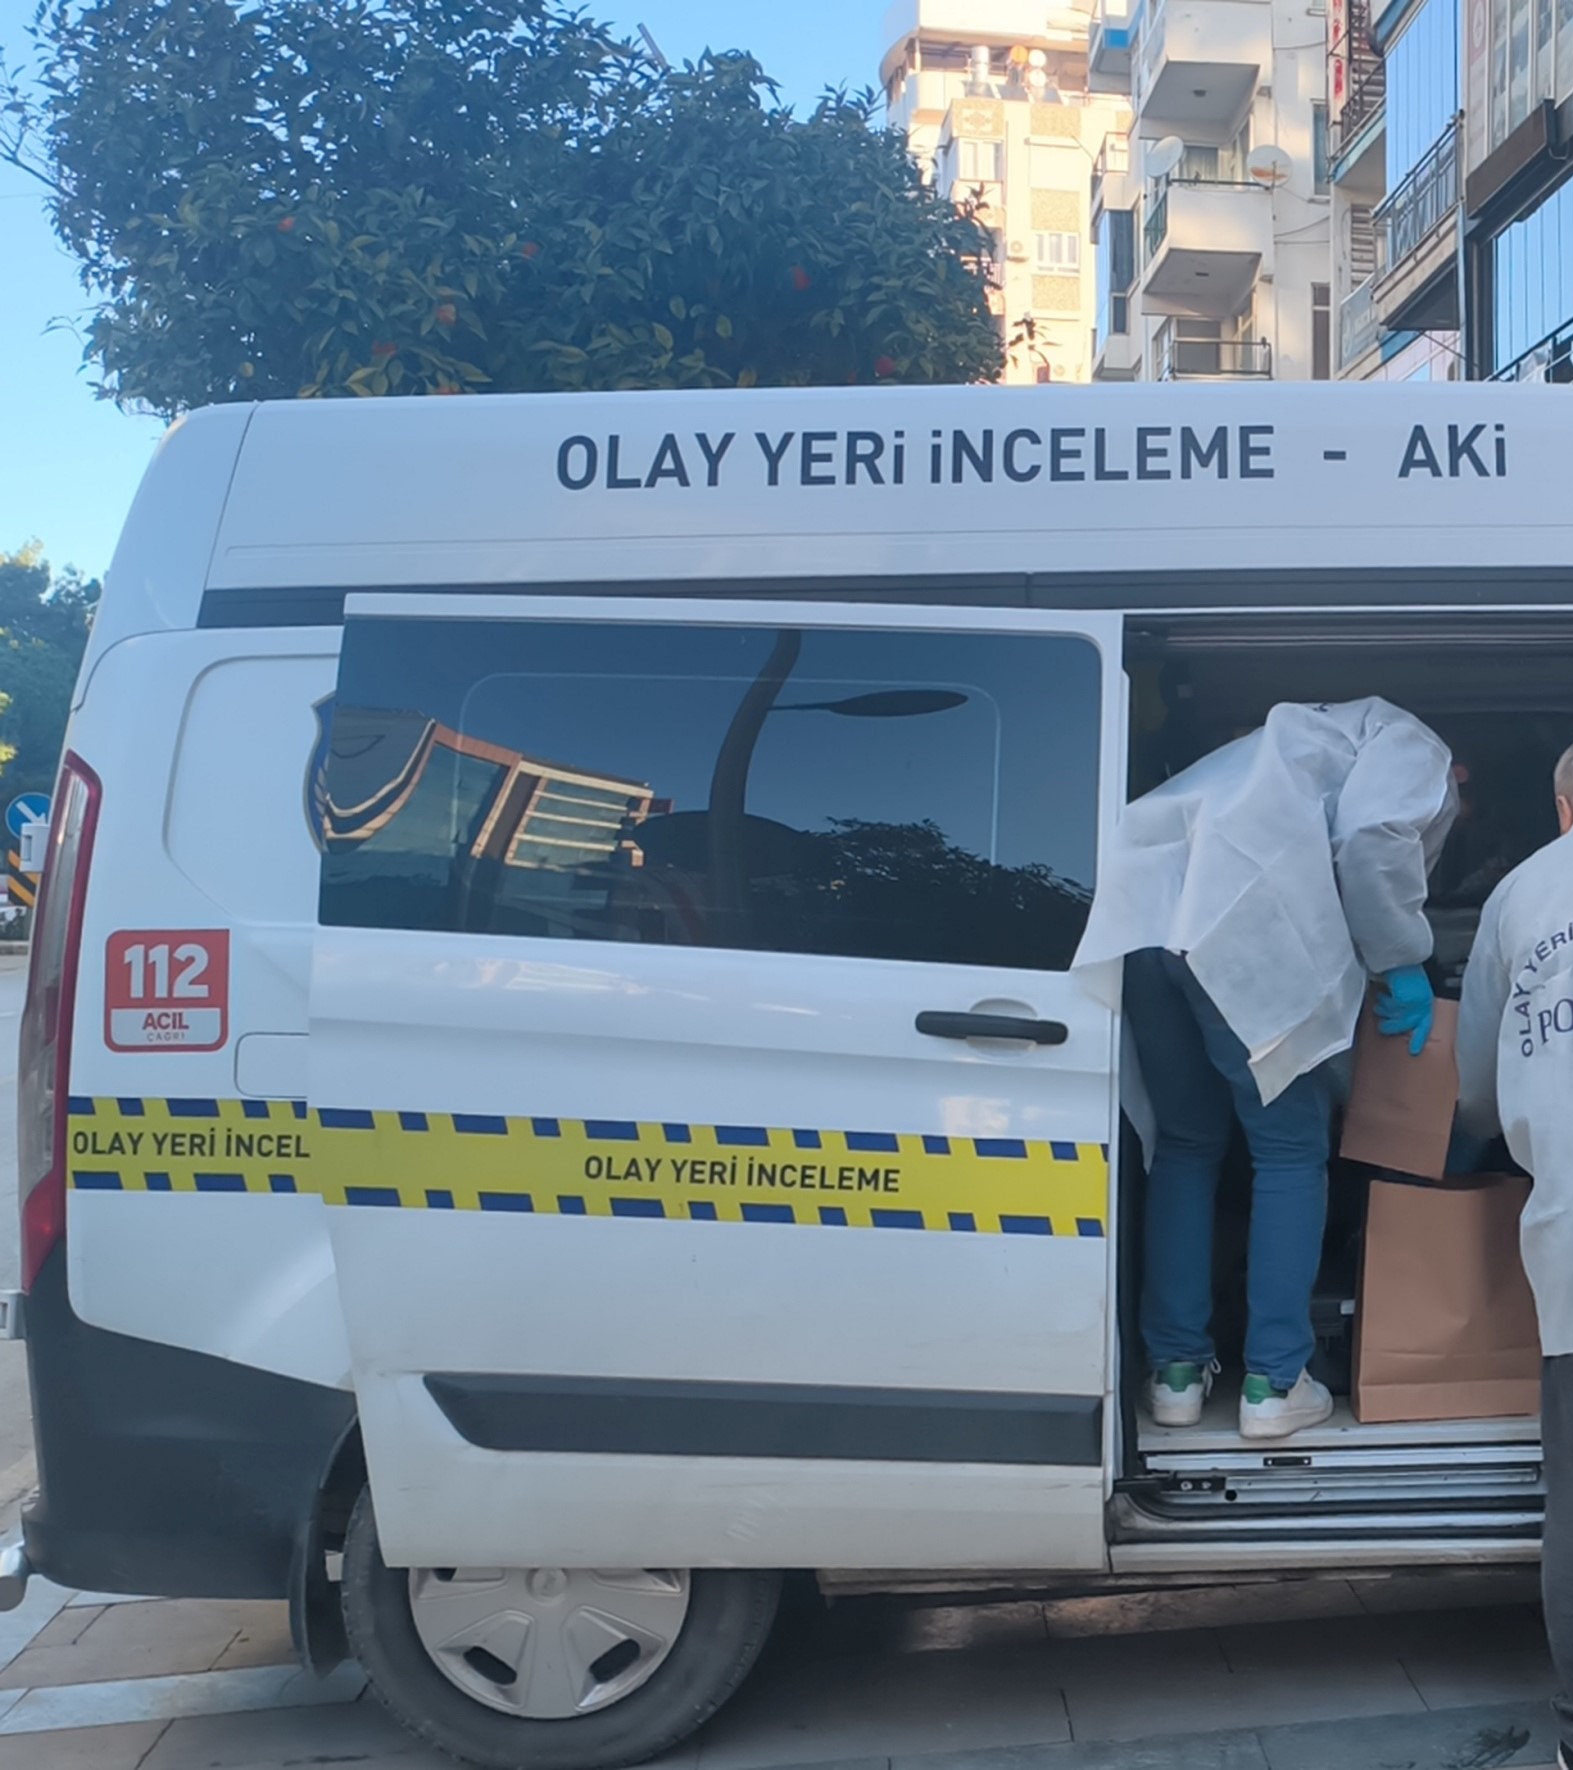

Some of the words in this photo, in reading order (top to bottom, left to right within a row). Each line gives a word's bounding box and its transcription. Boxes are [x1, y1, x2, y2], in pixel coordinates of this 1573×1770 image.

[557, 432, 736, 490] OLAY
[124, 944, 209, 998] 112
[1512, 982, 1534, 1057] OLAY
[72, 1131, 145, 1156] OLAY
[152, 1127, 216, 1157] YERİ
[584, 1155, 663, 1184] OLAY
[671, 1156, 738, 1186] YERİ
[747, 1156, 901, 1193] İNCELEME
